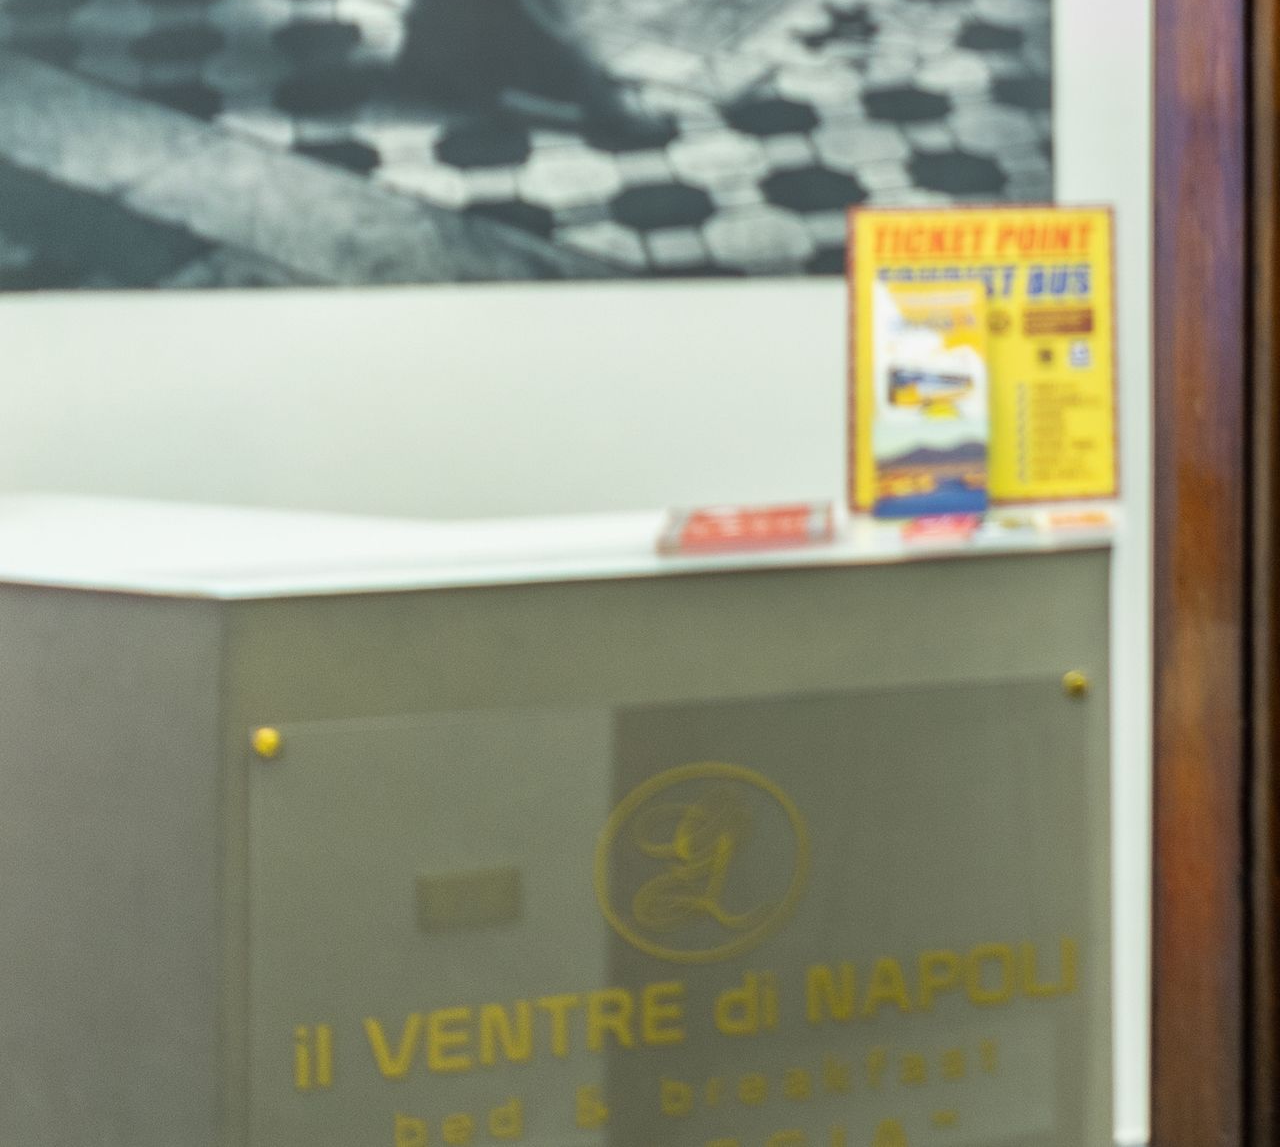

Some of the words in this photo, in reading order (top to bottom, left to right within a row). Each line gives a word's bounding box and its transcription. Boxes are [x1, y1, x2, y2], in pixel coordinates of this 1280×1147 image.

[874, 222, 987, 255] TICKET
[996, 220, 1093, 252] POINT
[1027, 264, 1091, 297] BUS
[293, 1024, 334, 1090] il
[365, 981, 688, 1079] VENTRE
[714, 970, 780, 1036] di
[805, 935, 1078, 1025] NAPOLI
[394, 1098, 523, 1147] bed
[661, 1038, 999, 1116] breakfast
